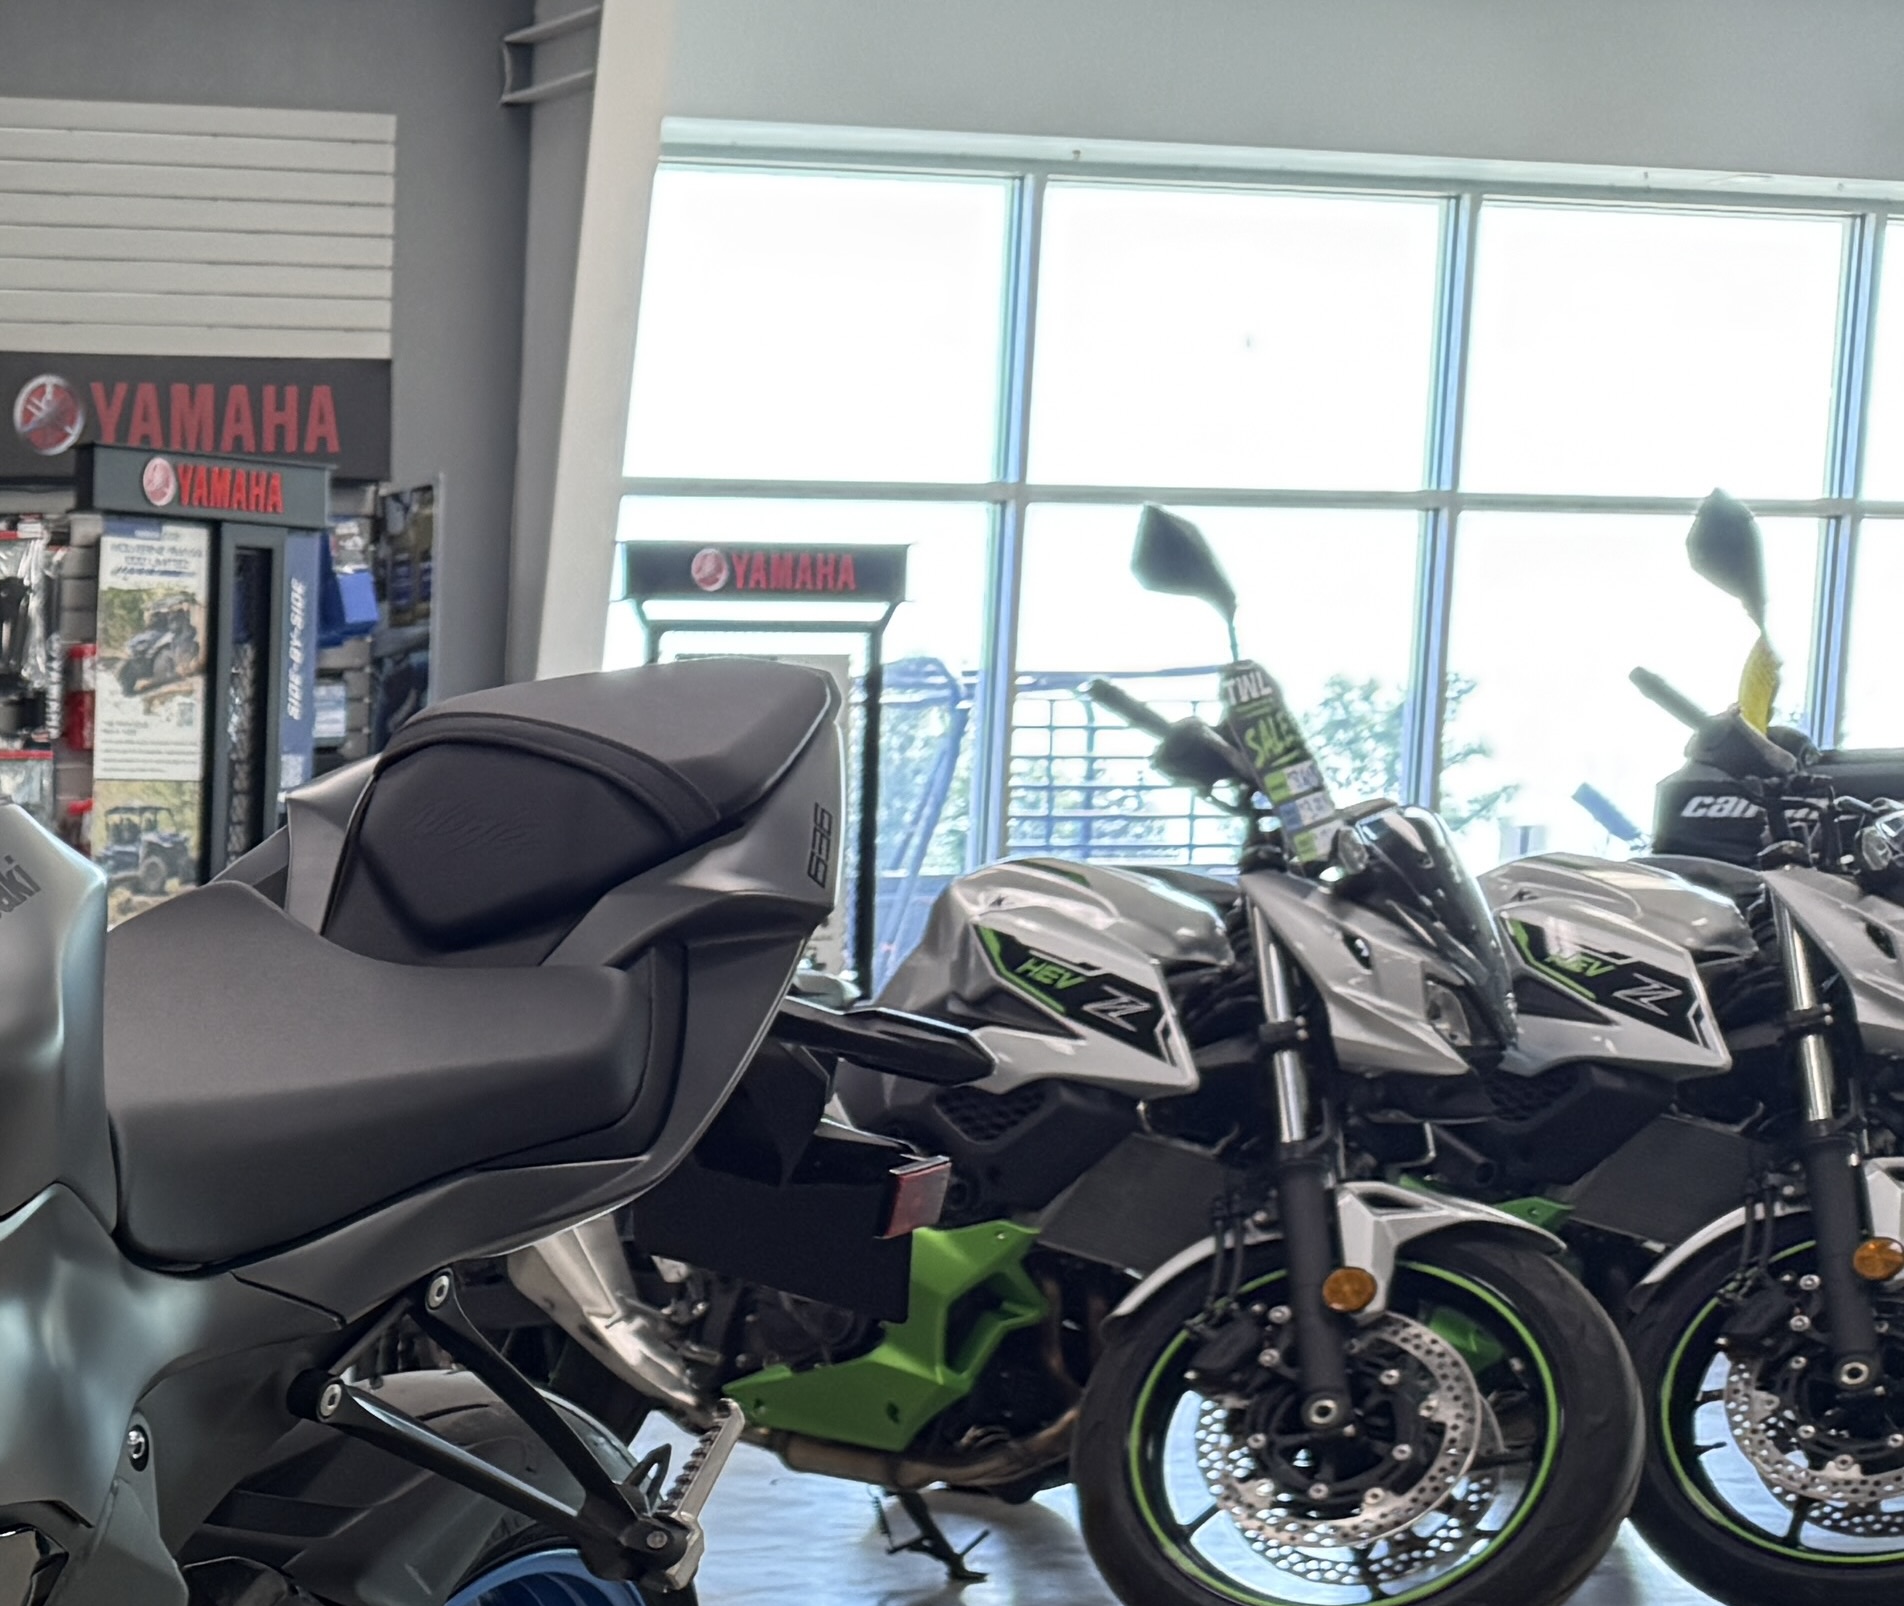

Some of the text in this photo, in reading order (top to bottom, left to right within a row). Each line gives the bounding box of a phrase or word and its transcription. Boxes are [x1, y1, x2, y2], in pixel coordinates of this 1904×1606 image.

[90, 381, 340, 453] YAMAHA
[176, 464, 284, 513] YAMAHA
[729, 551, 857, 591] YAMAHA
[1014, 957, 1088, 990] HEV
